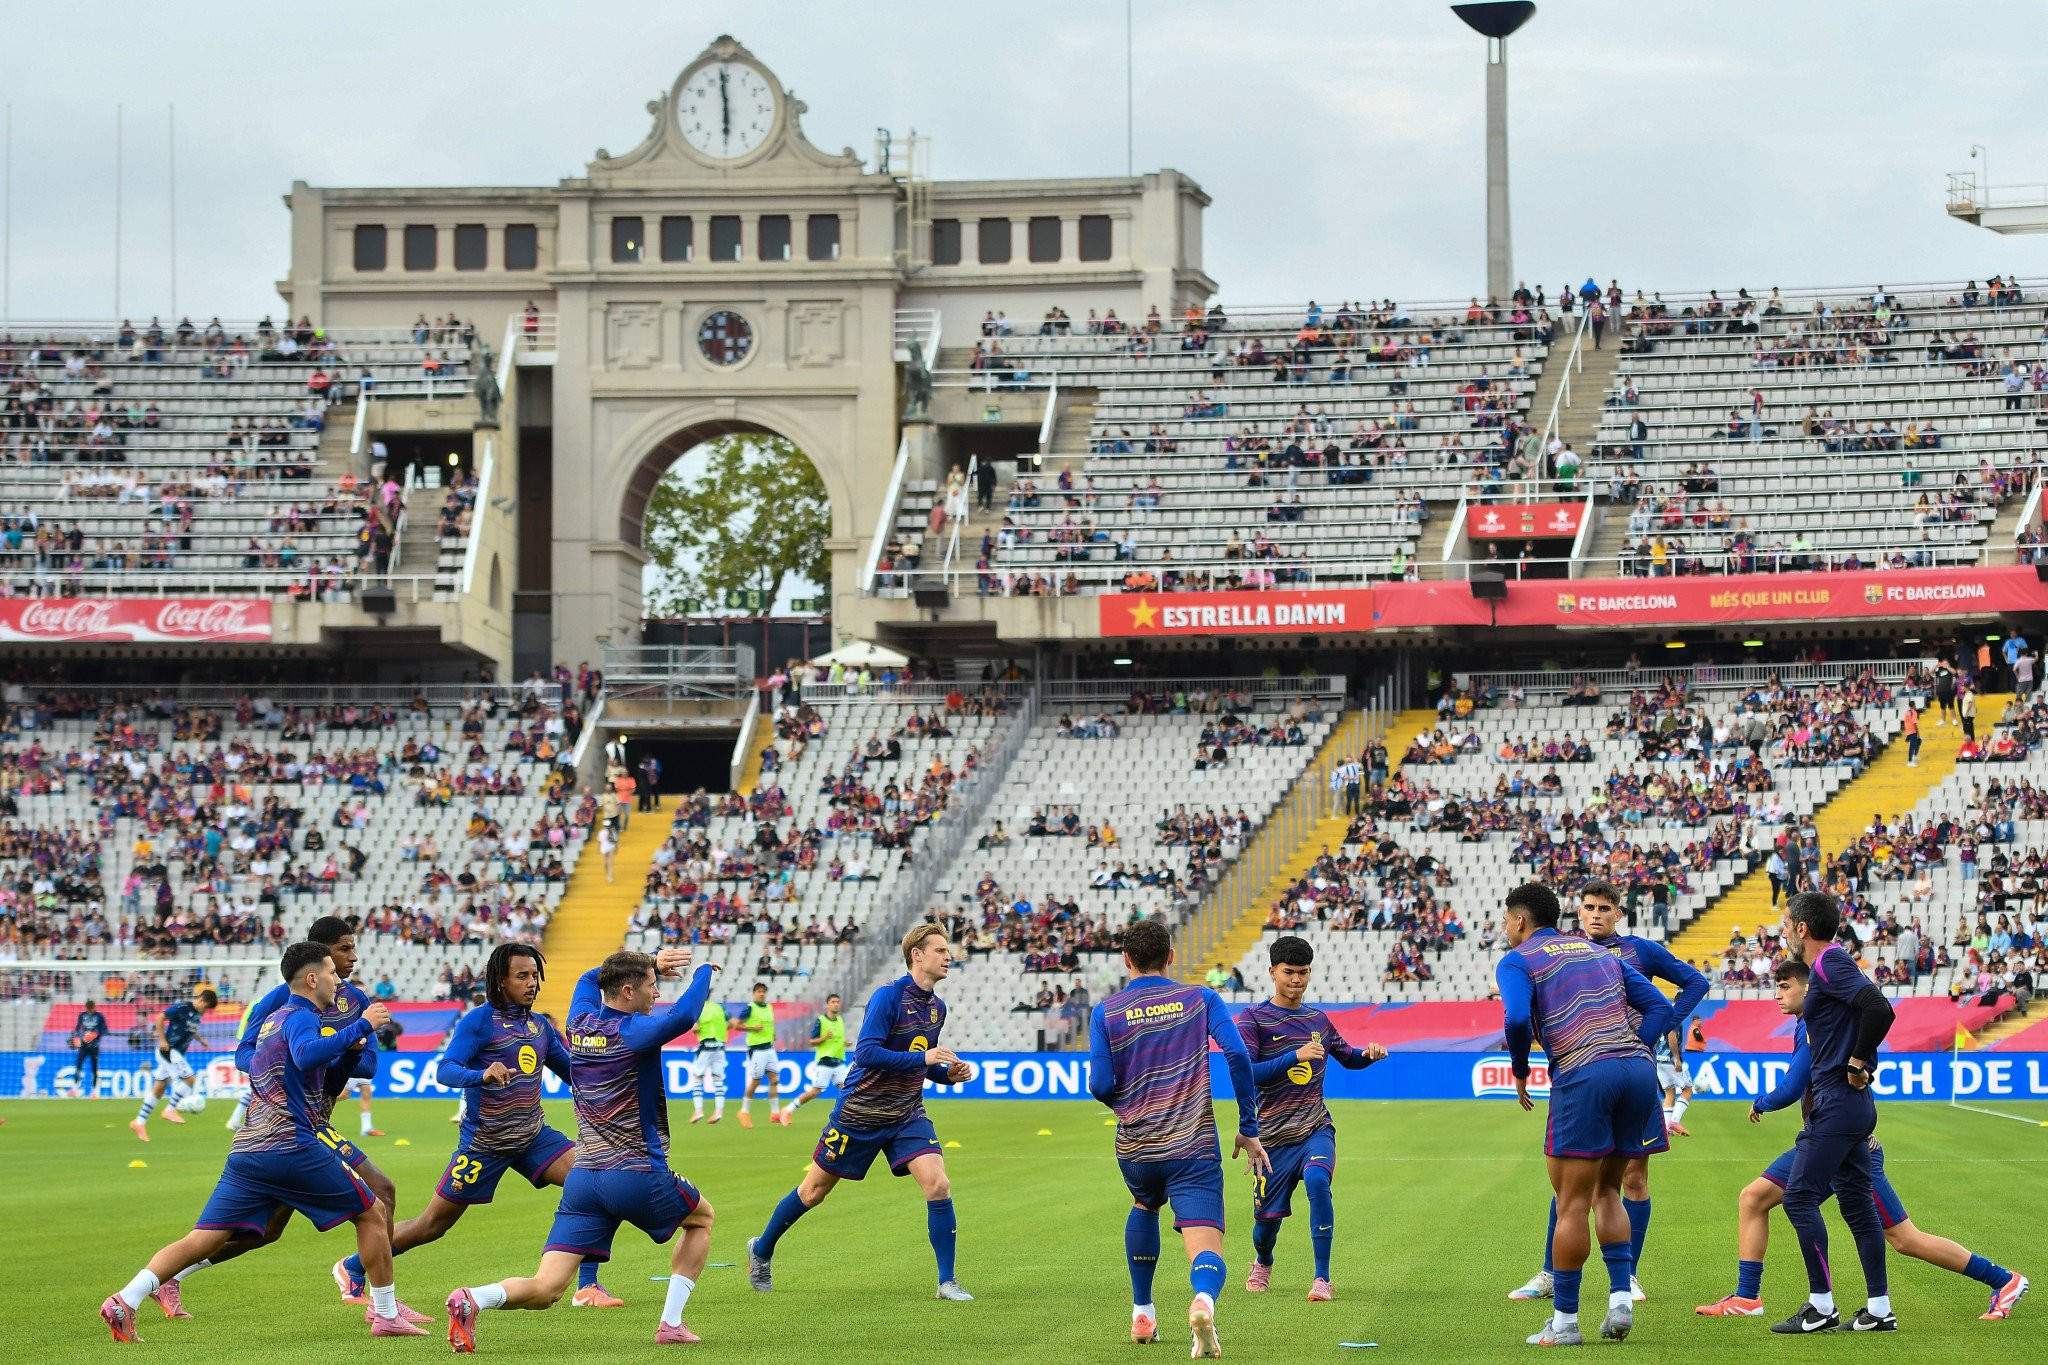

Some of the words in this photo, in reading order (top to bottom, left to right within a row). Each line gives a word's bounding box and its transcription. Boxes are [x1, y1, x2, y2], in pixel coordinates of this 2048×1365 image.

[1580, 597, 1596, 611] FC
[1598, 595, 1677, 611] BARCELONA
[1710, 591, 1739, 608] MÉS
[1741, 592, 1769, 608] QUE
[1772, 592, 1792, 605] UN
[1795, 589, 1830, 604] CLUB
[1887, 586, 1903, 601] FC
[1906, 584, 1985, 600] BARCELONA
[1162, 605, 1271, 628] ESTRELLA
[1274, 604, 1346, 626] DAMM
[1126, 1008, 1145, 1020] R.D.
[1146, 1002, 1184, 1017] CONGO
[1953, 1061, 2012, 1094] DE
[825, 1128, 849, 1155] 21
[451, 1155, 483, 1184] 23
